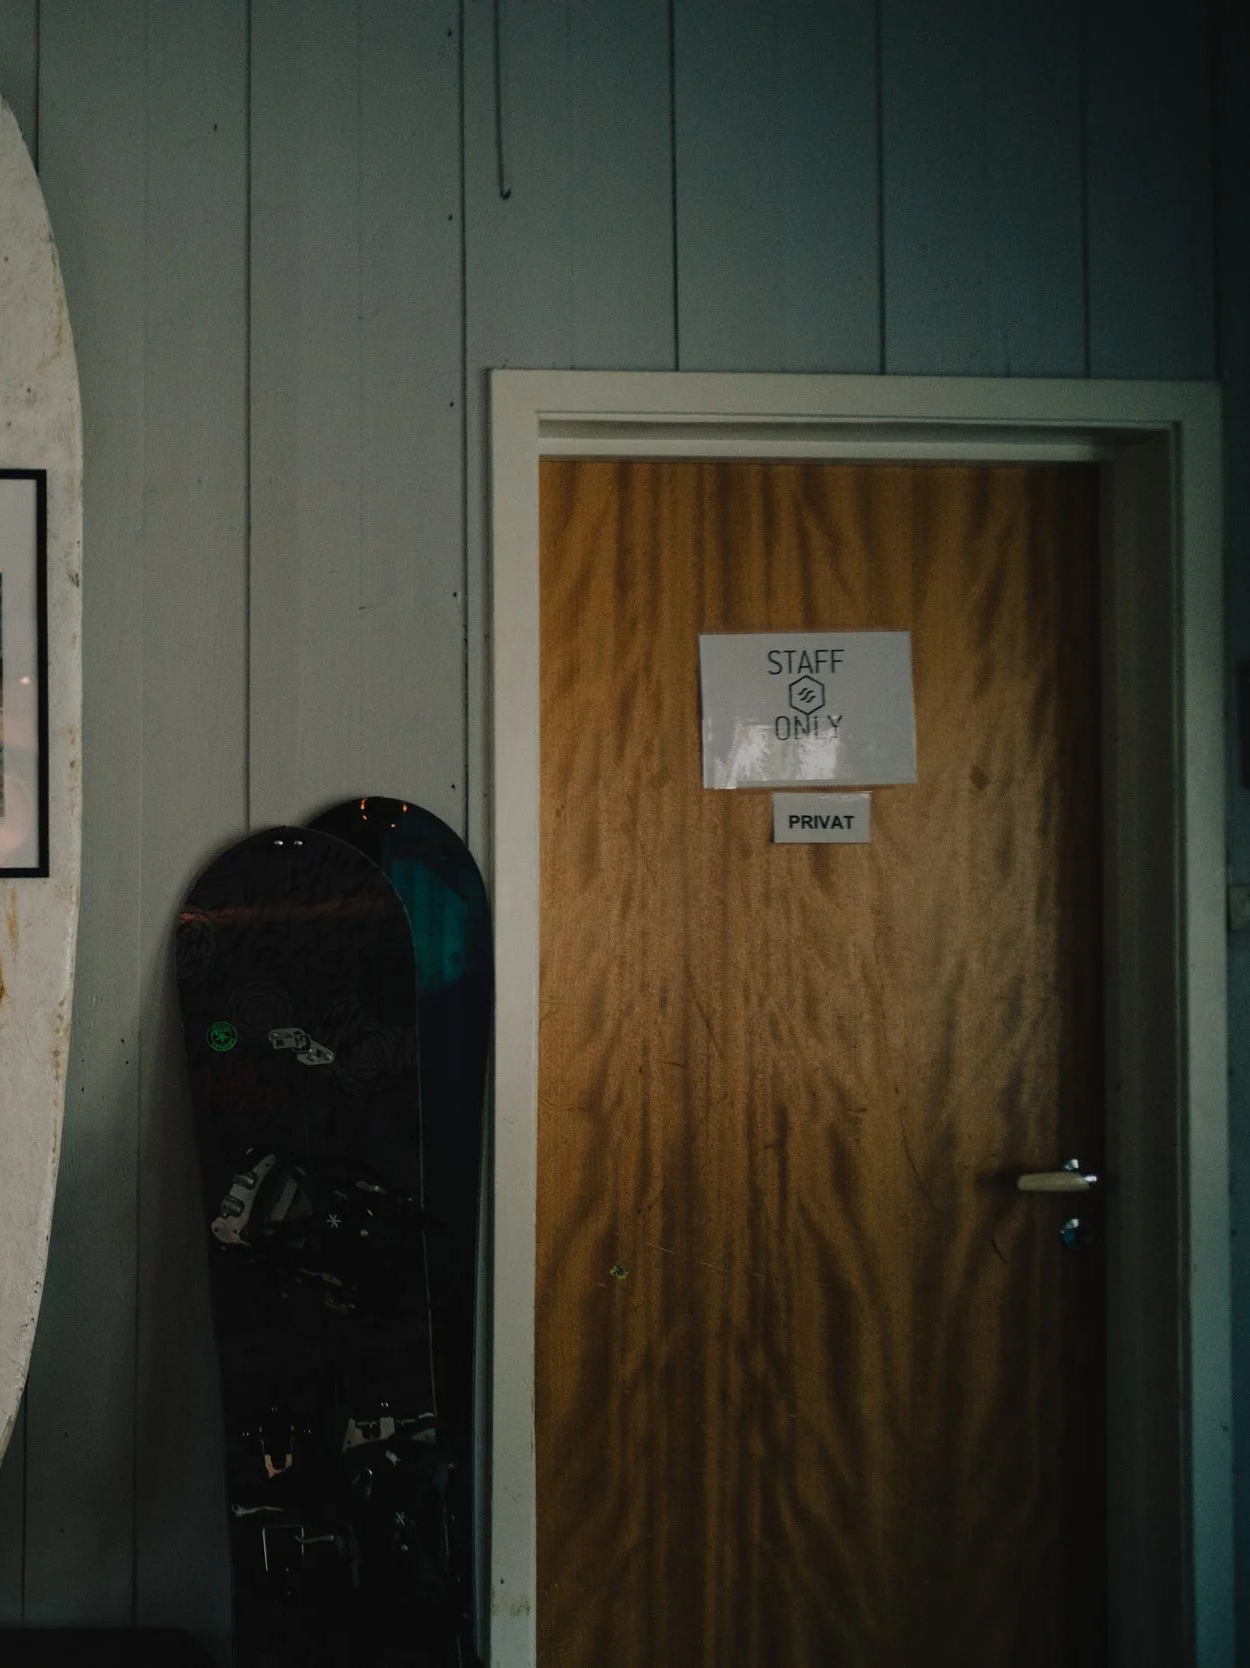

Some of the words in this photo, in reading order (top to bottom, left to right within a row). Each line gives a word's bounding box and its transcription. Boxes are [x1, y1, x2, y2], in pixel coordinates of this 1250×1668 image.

[767, 648, 845, 676] STAFF
[775, 715, 843, 741] ONLY
[789, 815, 855, 830] PRIVAT
